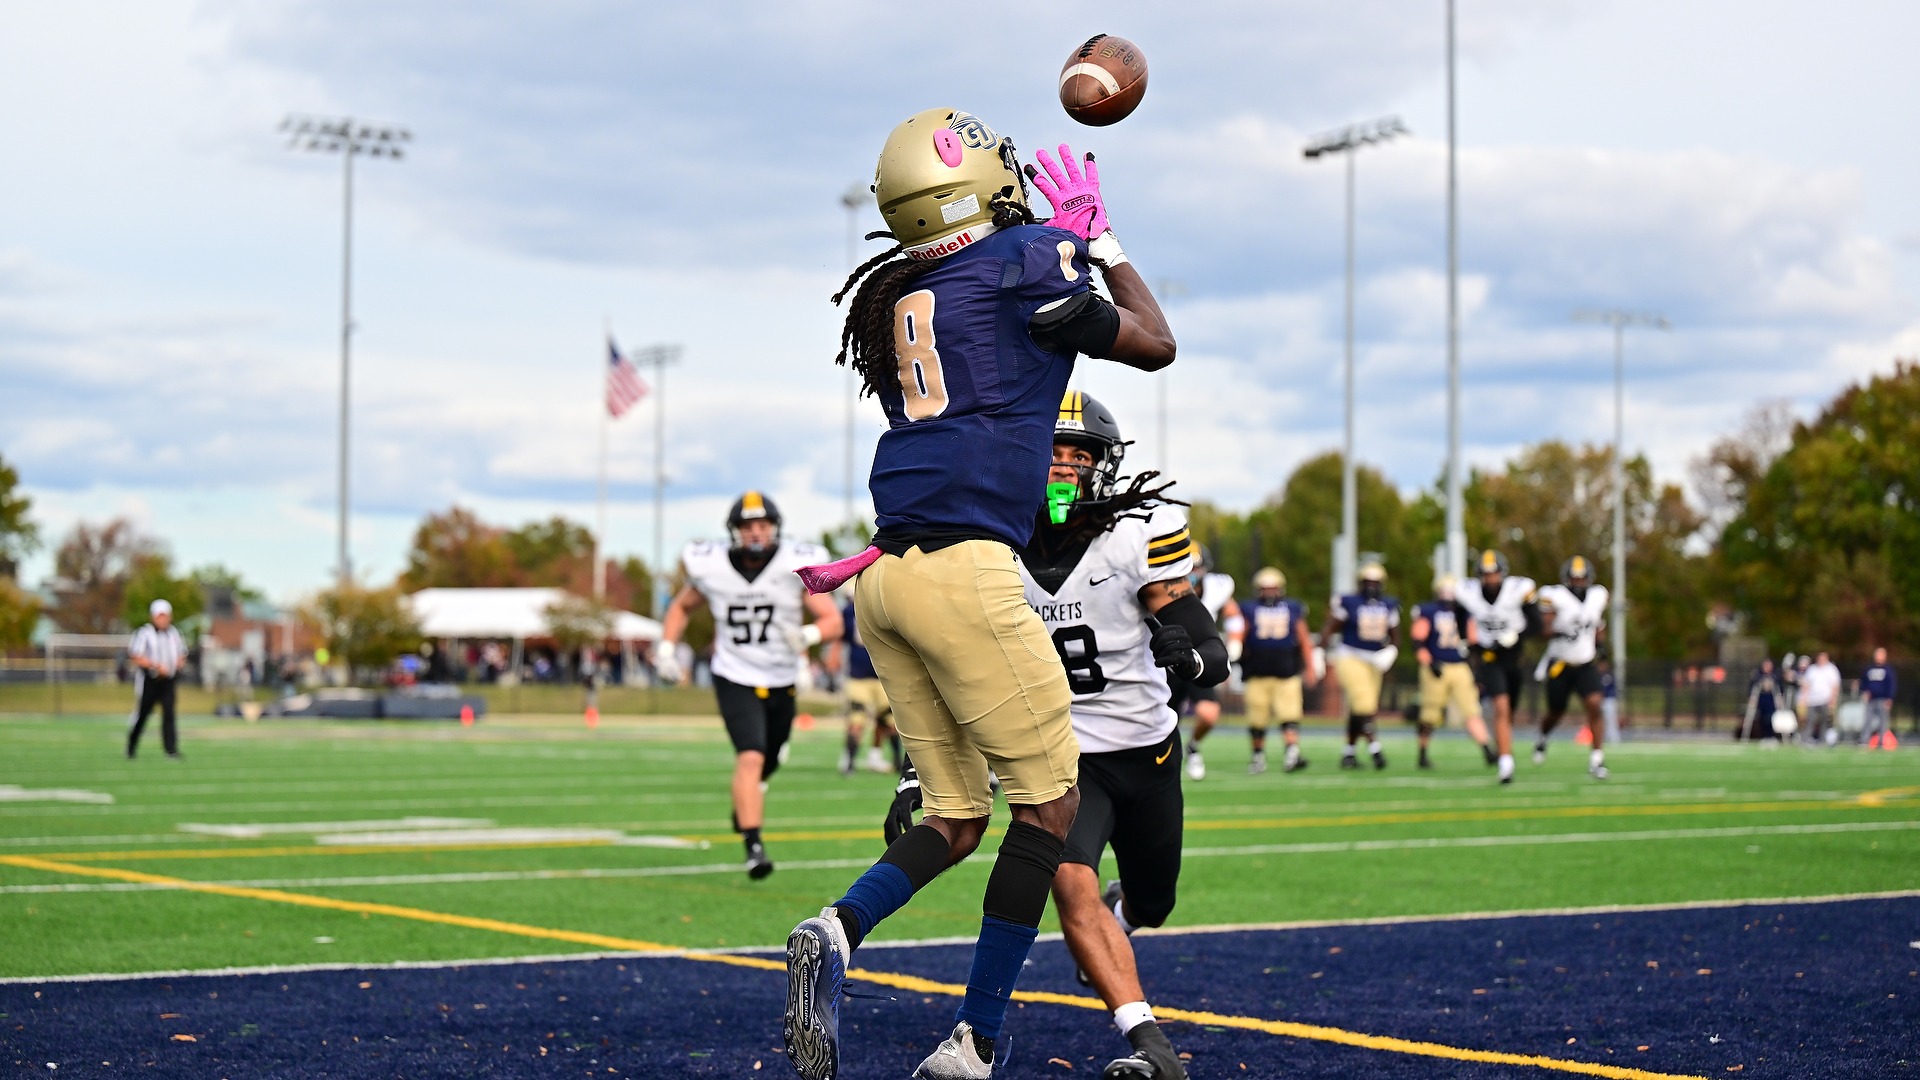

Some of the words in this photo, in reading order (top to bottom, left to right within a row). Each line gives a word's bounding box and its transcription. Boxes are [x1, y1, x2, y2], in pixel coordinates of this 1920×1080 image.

[1064, 195, 1093, 210] BATTLE
[909, 232, 973, 260] Riddell
[894, 289, 950, 422] 8
[728, 605, 774, 644] 57
[1031, 601, 1082, 621] ACKETS
[1051, 624, 1109, 695] 8
